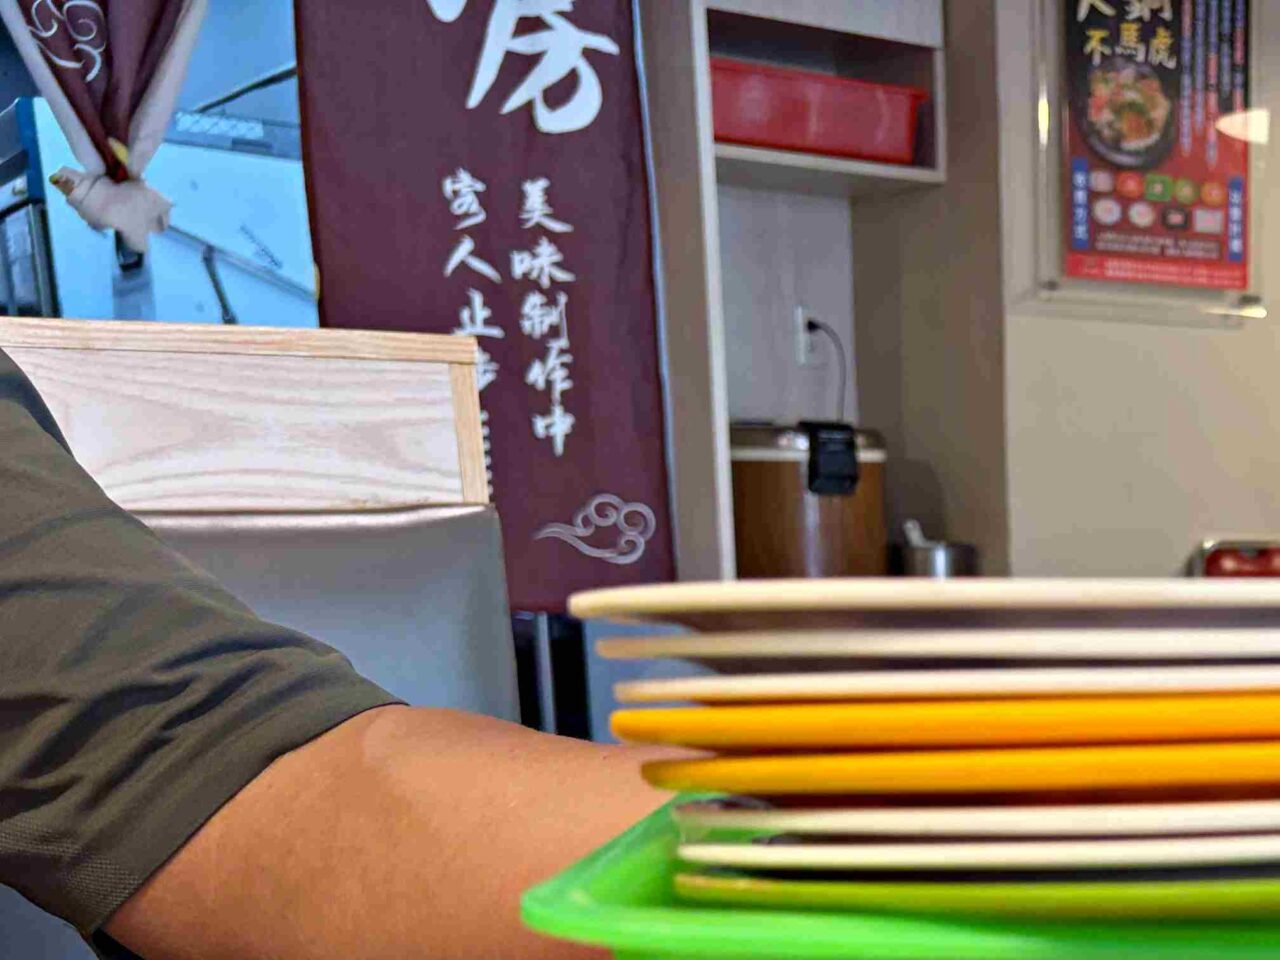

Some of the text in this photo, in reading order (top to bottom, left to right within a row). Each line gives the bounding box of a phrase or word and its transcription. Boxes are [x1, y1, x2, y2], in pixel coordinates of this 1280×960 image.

[509, 177, 577, 456] 美味制作中
